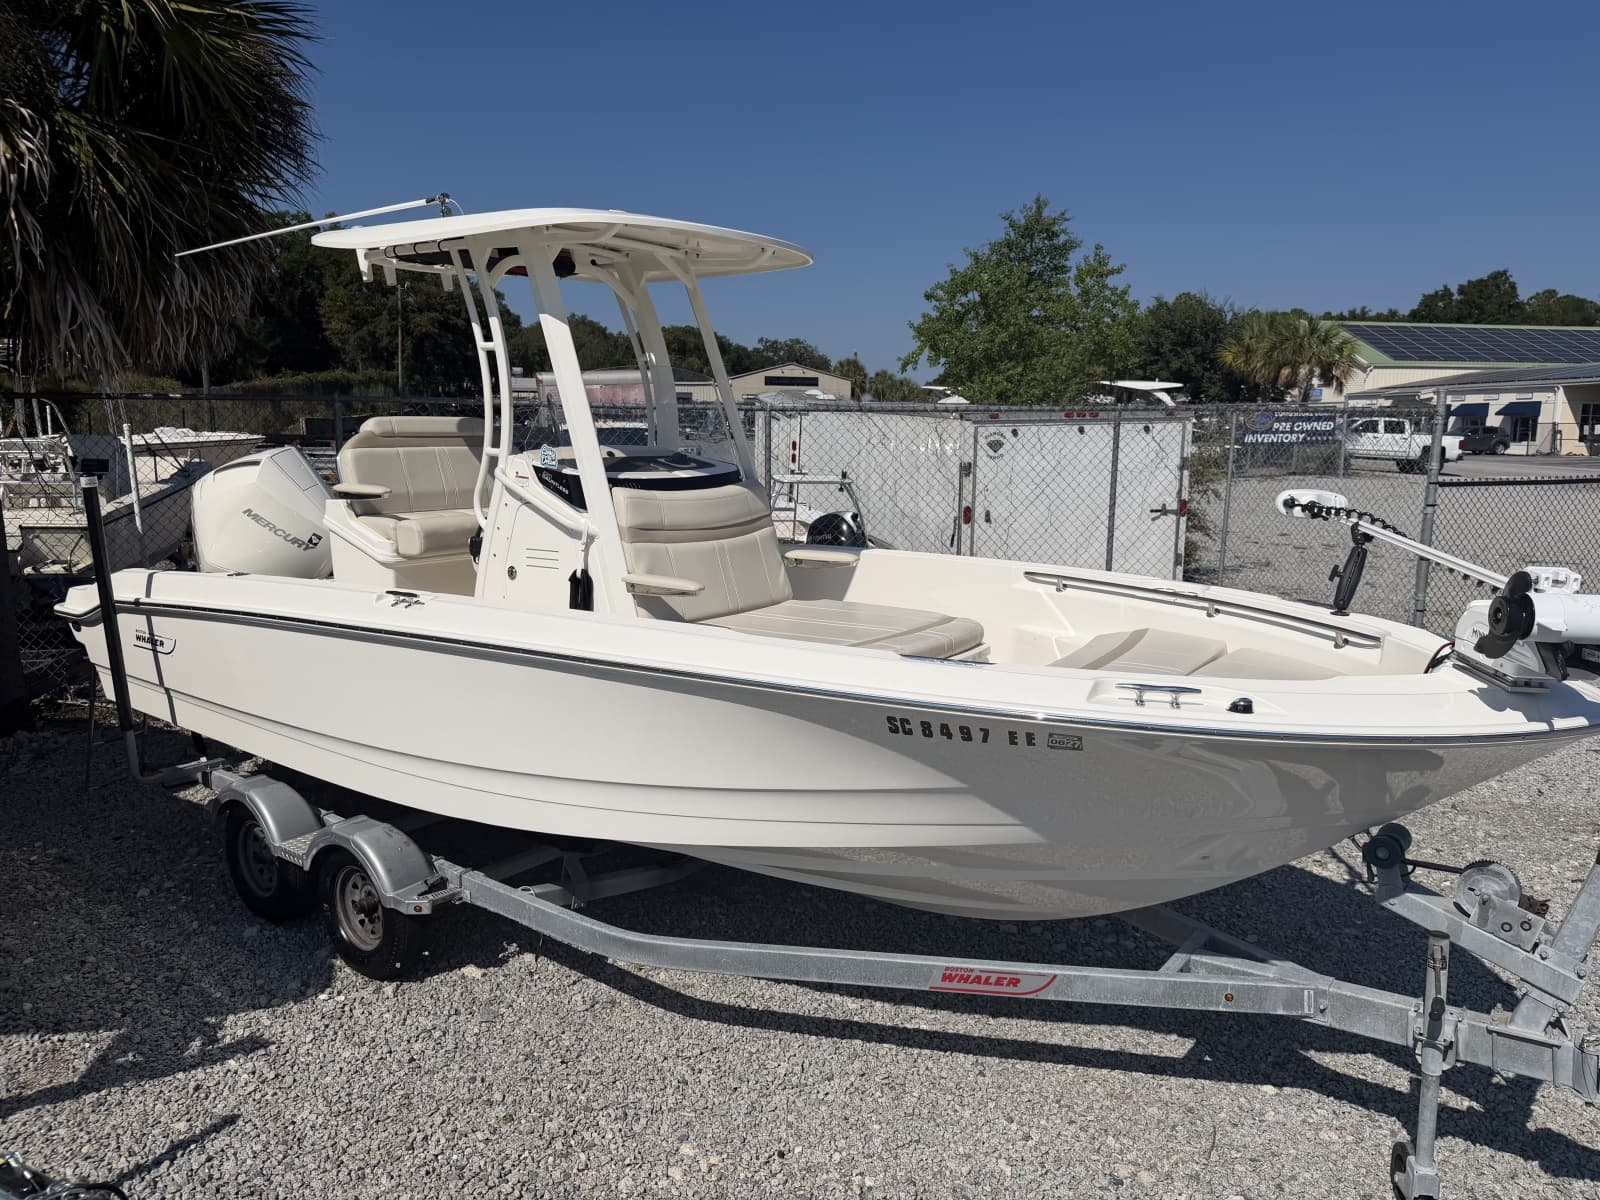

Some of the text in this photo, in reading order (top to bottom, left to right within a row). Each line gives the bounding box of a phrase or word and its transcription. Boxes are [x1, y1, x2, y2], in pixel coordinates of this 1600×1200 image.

[1272, 421, 1334, 431] PRE OWNED
[1244, 433, 1305, 443] INVENTORY
[242, 508, 317, 551] MERCURY
[135, 633, 165, 649] WHALER
[886, 715, 914, 736] SC
[944, 966, 975, 974] BOSTON
[940, 972, 1022, 988] WHALER
